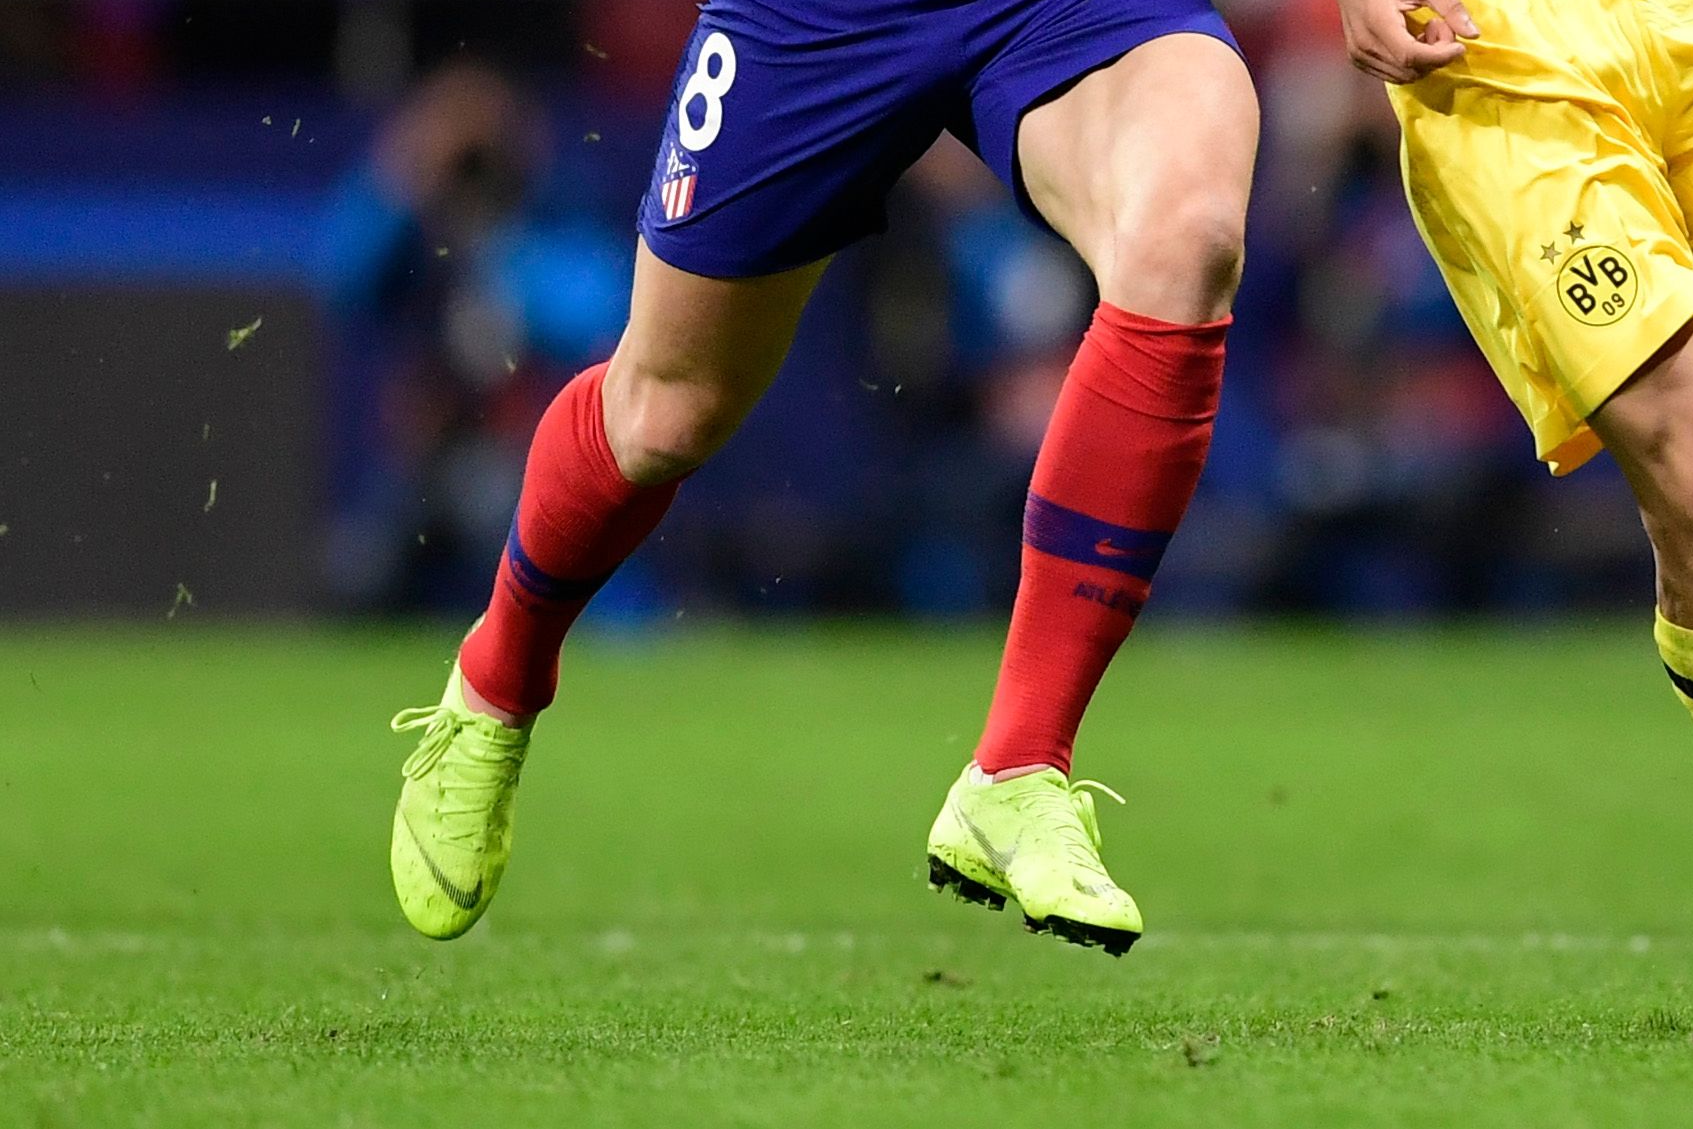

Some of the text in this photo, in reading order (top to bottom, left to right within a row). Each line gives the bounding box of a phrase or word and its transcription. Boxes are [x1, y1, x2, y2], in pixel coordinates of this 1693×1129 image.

[678, 31, 737, 152] 8
[1565, 254, 1629, 316] BVB
[1602, 293, 1625, 316] 09
